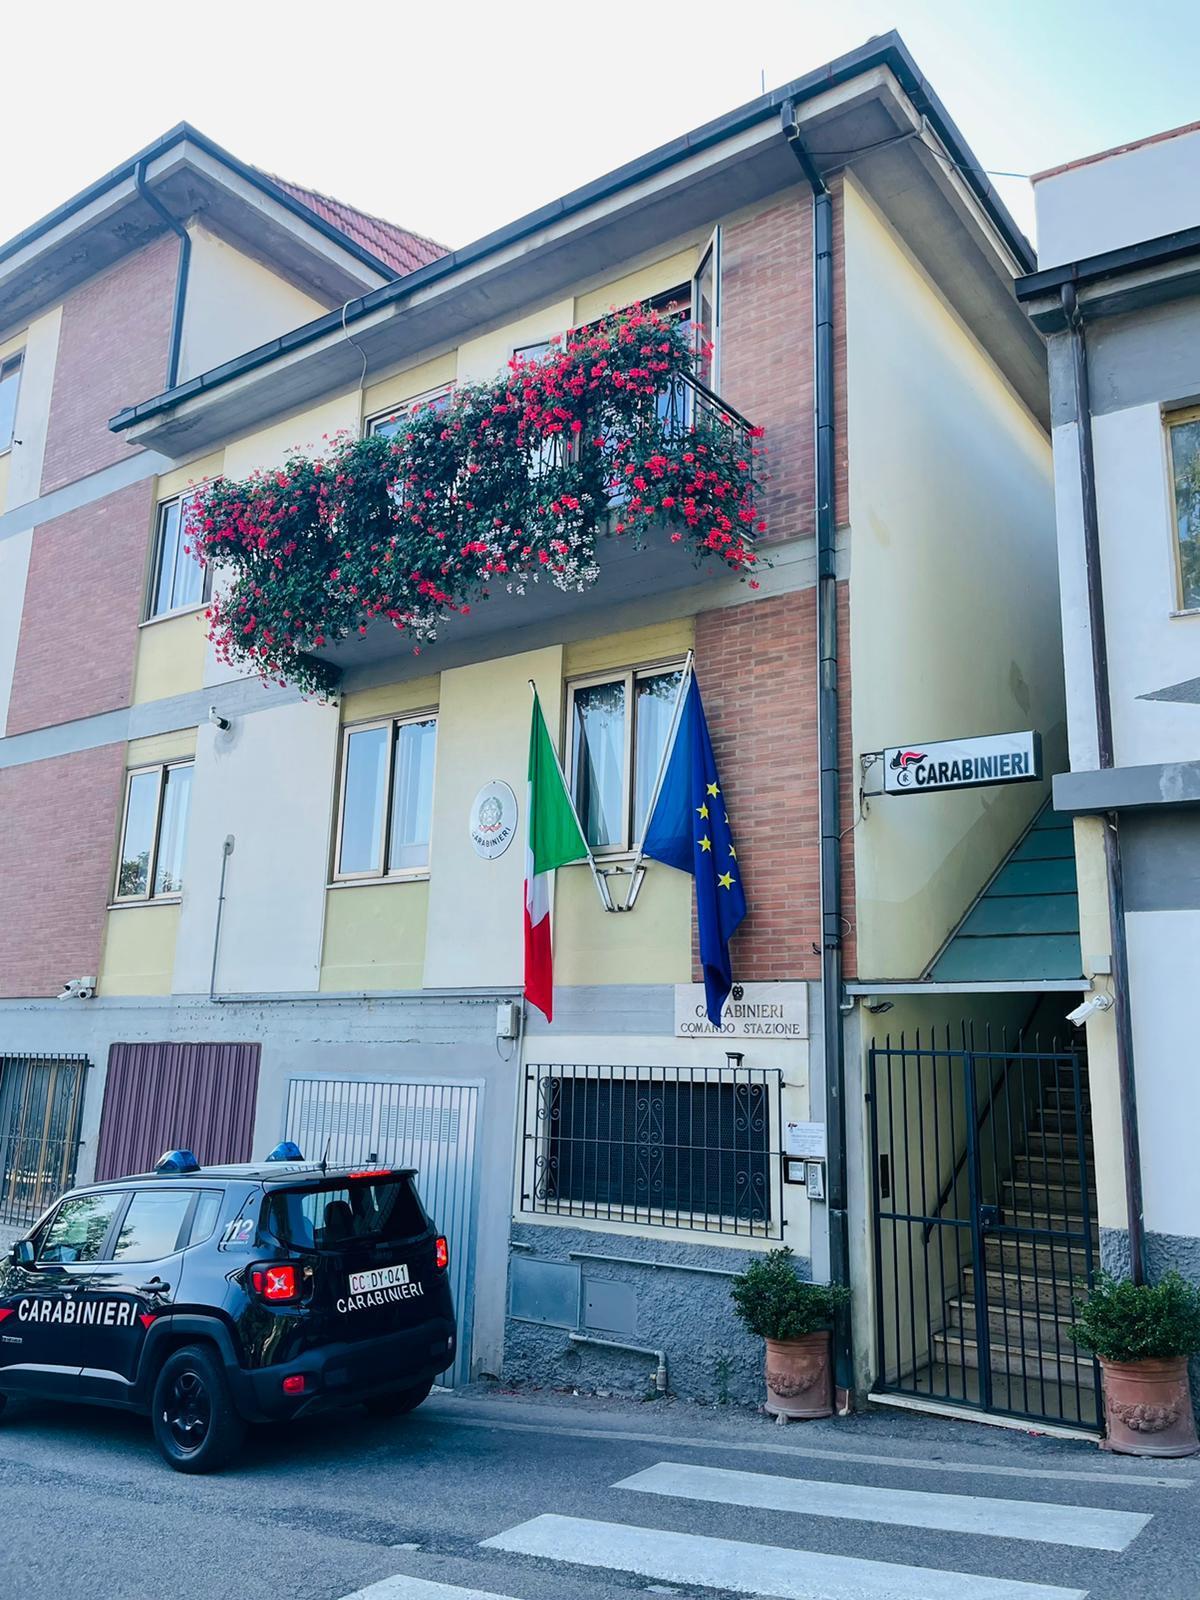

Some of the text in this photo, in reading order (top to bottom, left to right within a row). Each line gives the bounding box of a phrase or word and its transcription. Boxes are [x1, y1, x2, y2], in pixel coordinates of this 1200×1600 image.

[915, 752, 1028, 785] CARABINIERI
[472, 827, 511, 848] CARABINIERI
[695, 1004, 783, 1018] CABINIERI
[743, 1023, 800, 1035] STAZIONE
[225, 1219, 254, 1240] 112
[371, 1271, 384, 1288] DY
[387, 1266, 406, 1284] 041
[336, 1282, 424, 1313] CARABINIERI
[18, 1298, 138, 1326] CARABINIERI
